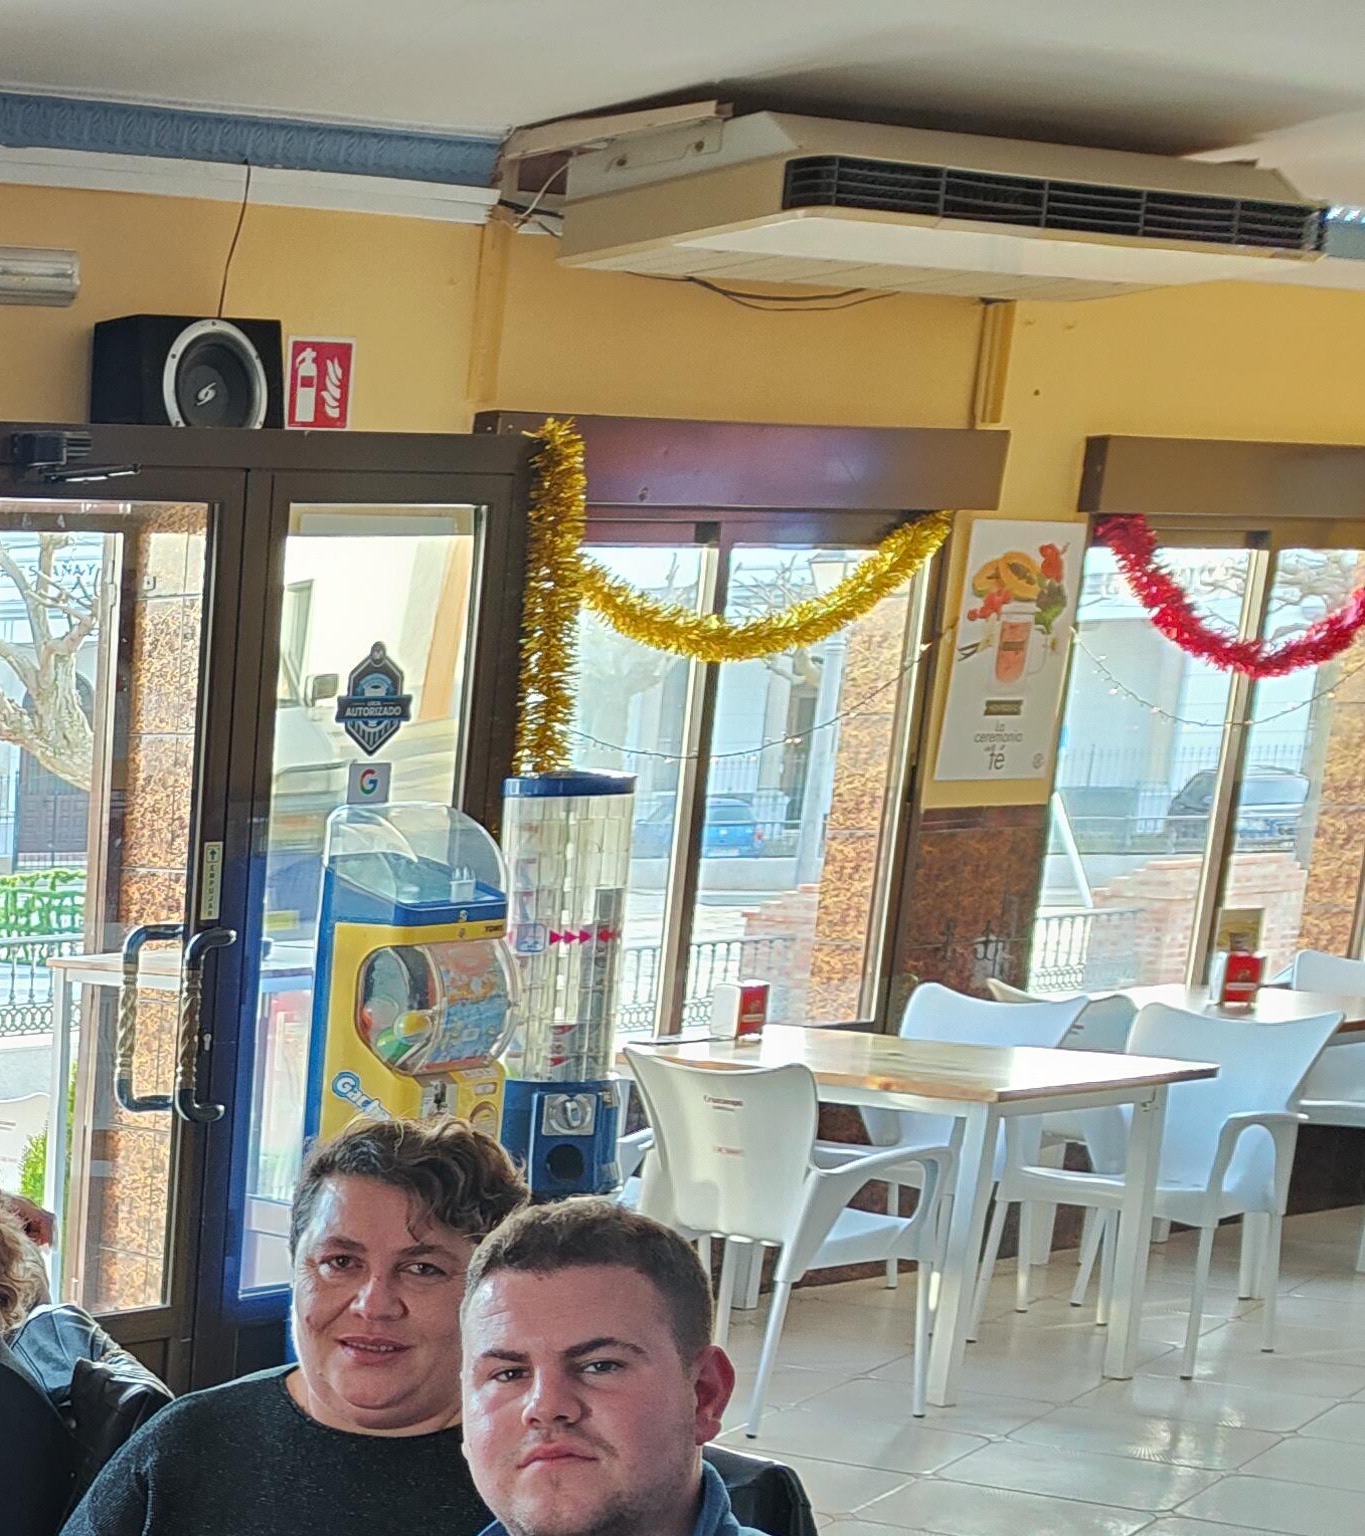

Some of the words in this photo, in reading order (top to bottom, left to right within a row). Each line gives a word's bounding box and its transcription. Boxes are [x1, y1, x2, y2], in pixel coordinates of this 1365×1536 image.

[345, 705, 402, 717] AUTORIZADO
[974, 731, 1023, 743] ceremonia
[359, 768, 378, 795] G
[207, 864, 216, 917] EMPUJAR
